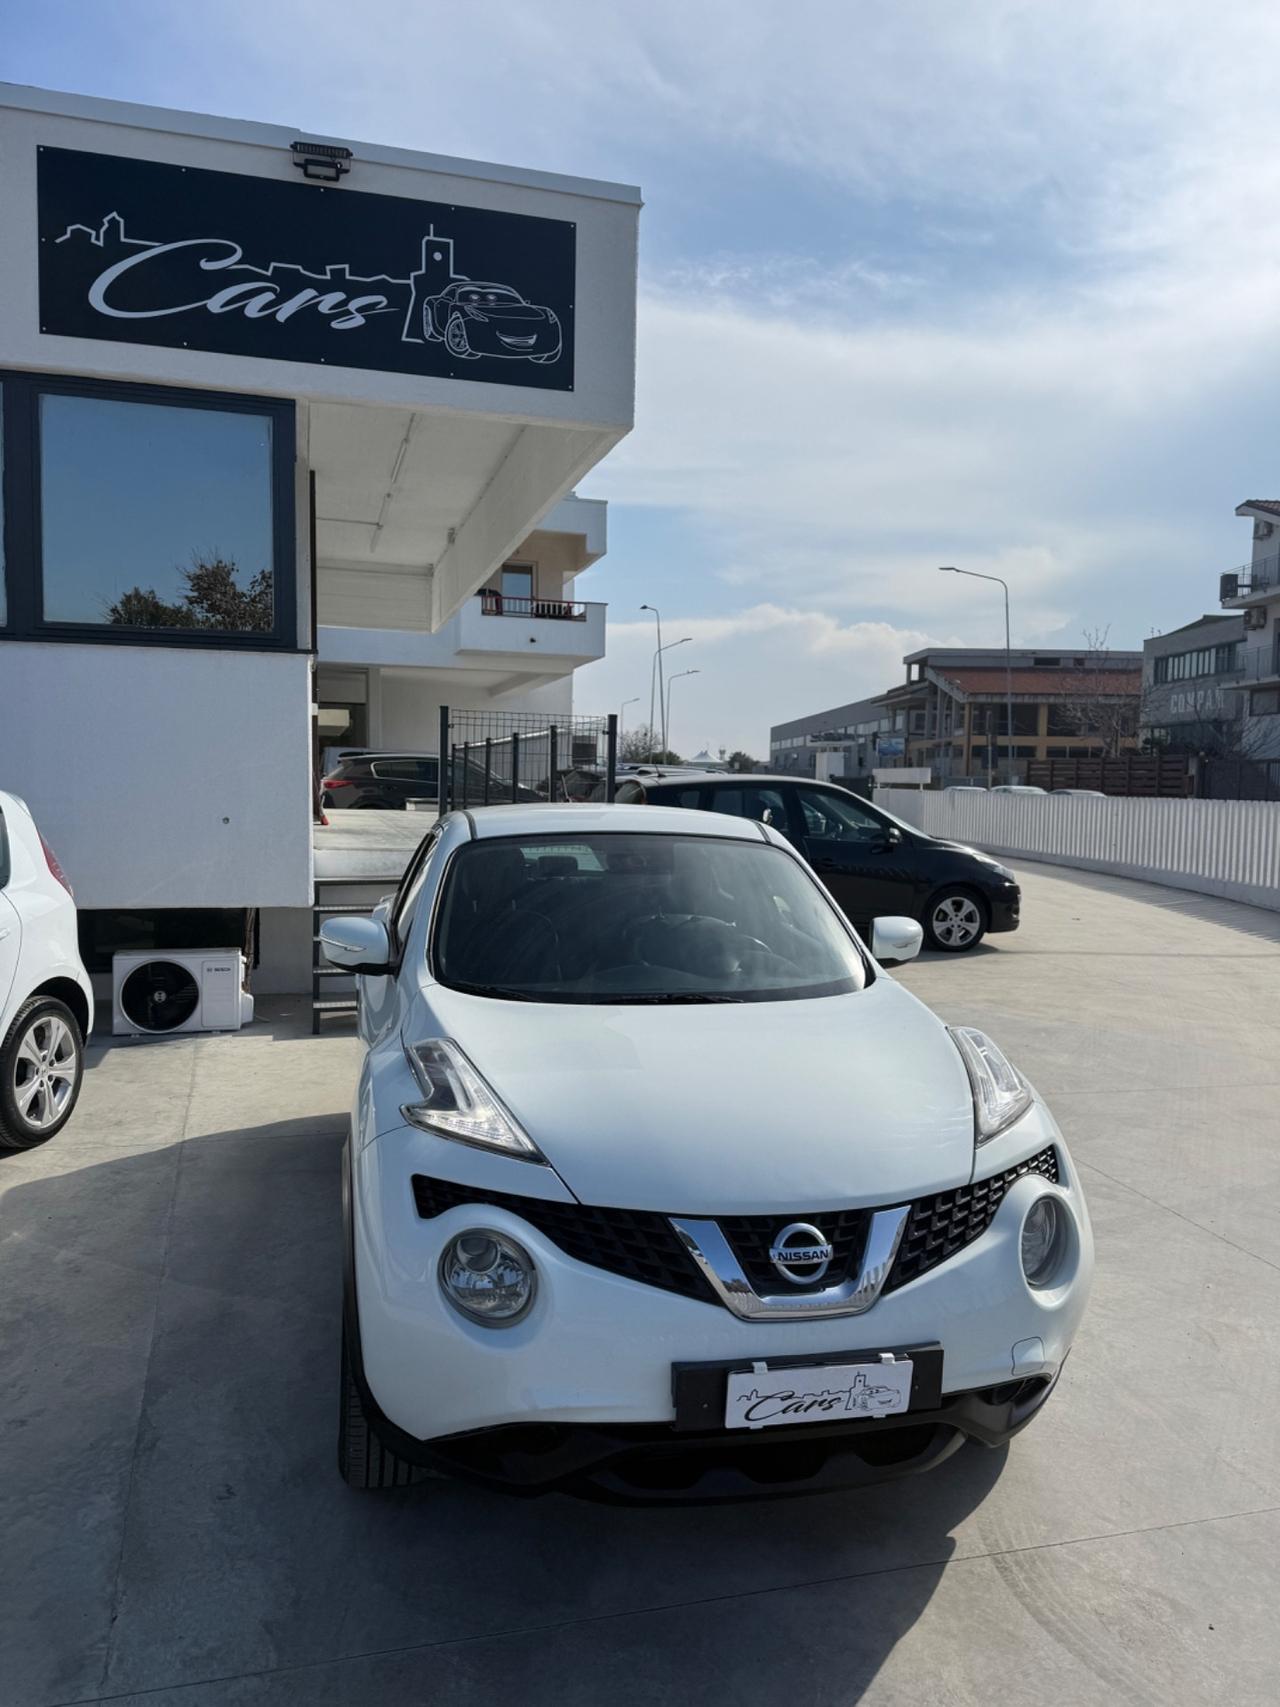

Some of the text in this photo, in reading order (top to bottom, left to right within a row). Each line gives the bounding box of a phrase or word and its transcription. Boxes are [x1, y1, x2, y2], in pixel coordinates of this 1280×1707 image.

[88, 238, 401, 330] Cars
[778, 1249, 829, 1261] NISSAN
[744, 1390, 842, 1421] Cars
